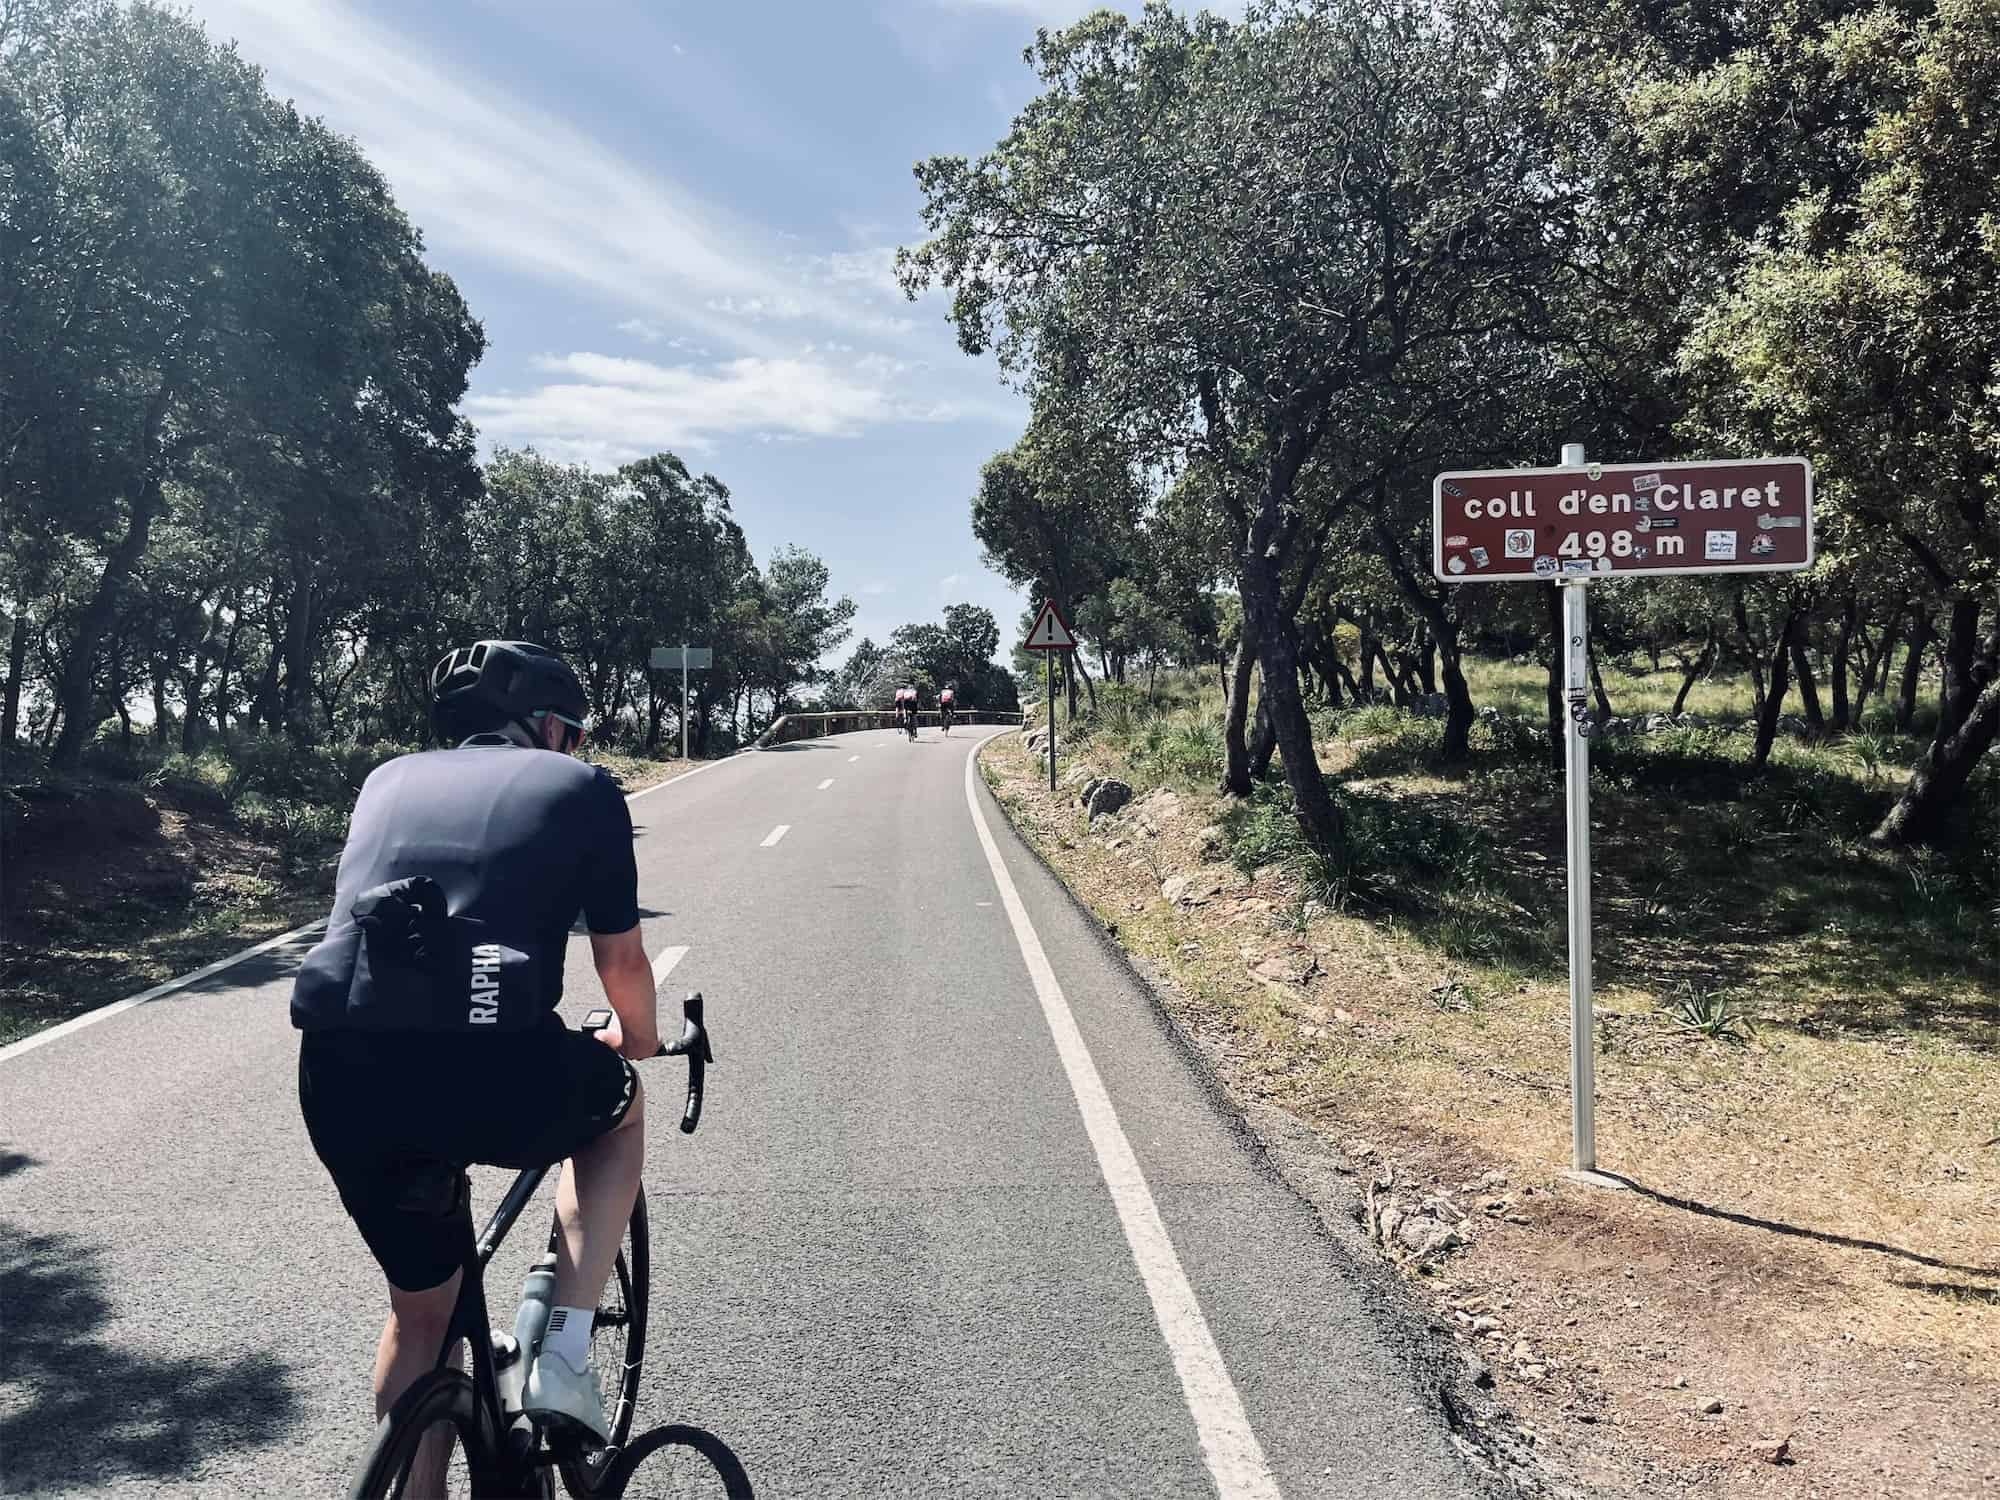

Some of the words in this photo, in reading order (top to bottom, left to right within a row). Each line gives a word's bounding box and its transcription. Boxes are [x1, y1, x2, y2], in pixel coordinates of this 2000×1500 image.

[1464, 490, 1537, 519] coll
[1558, 489, 1631, 515] d'en
[1654, 480, 1782, 511] Claret
[1558, 530, 1633, 558] 498
[1656, 535, 1684, 555] m
[469, 943, 500, 1024] RAPHA
